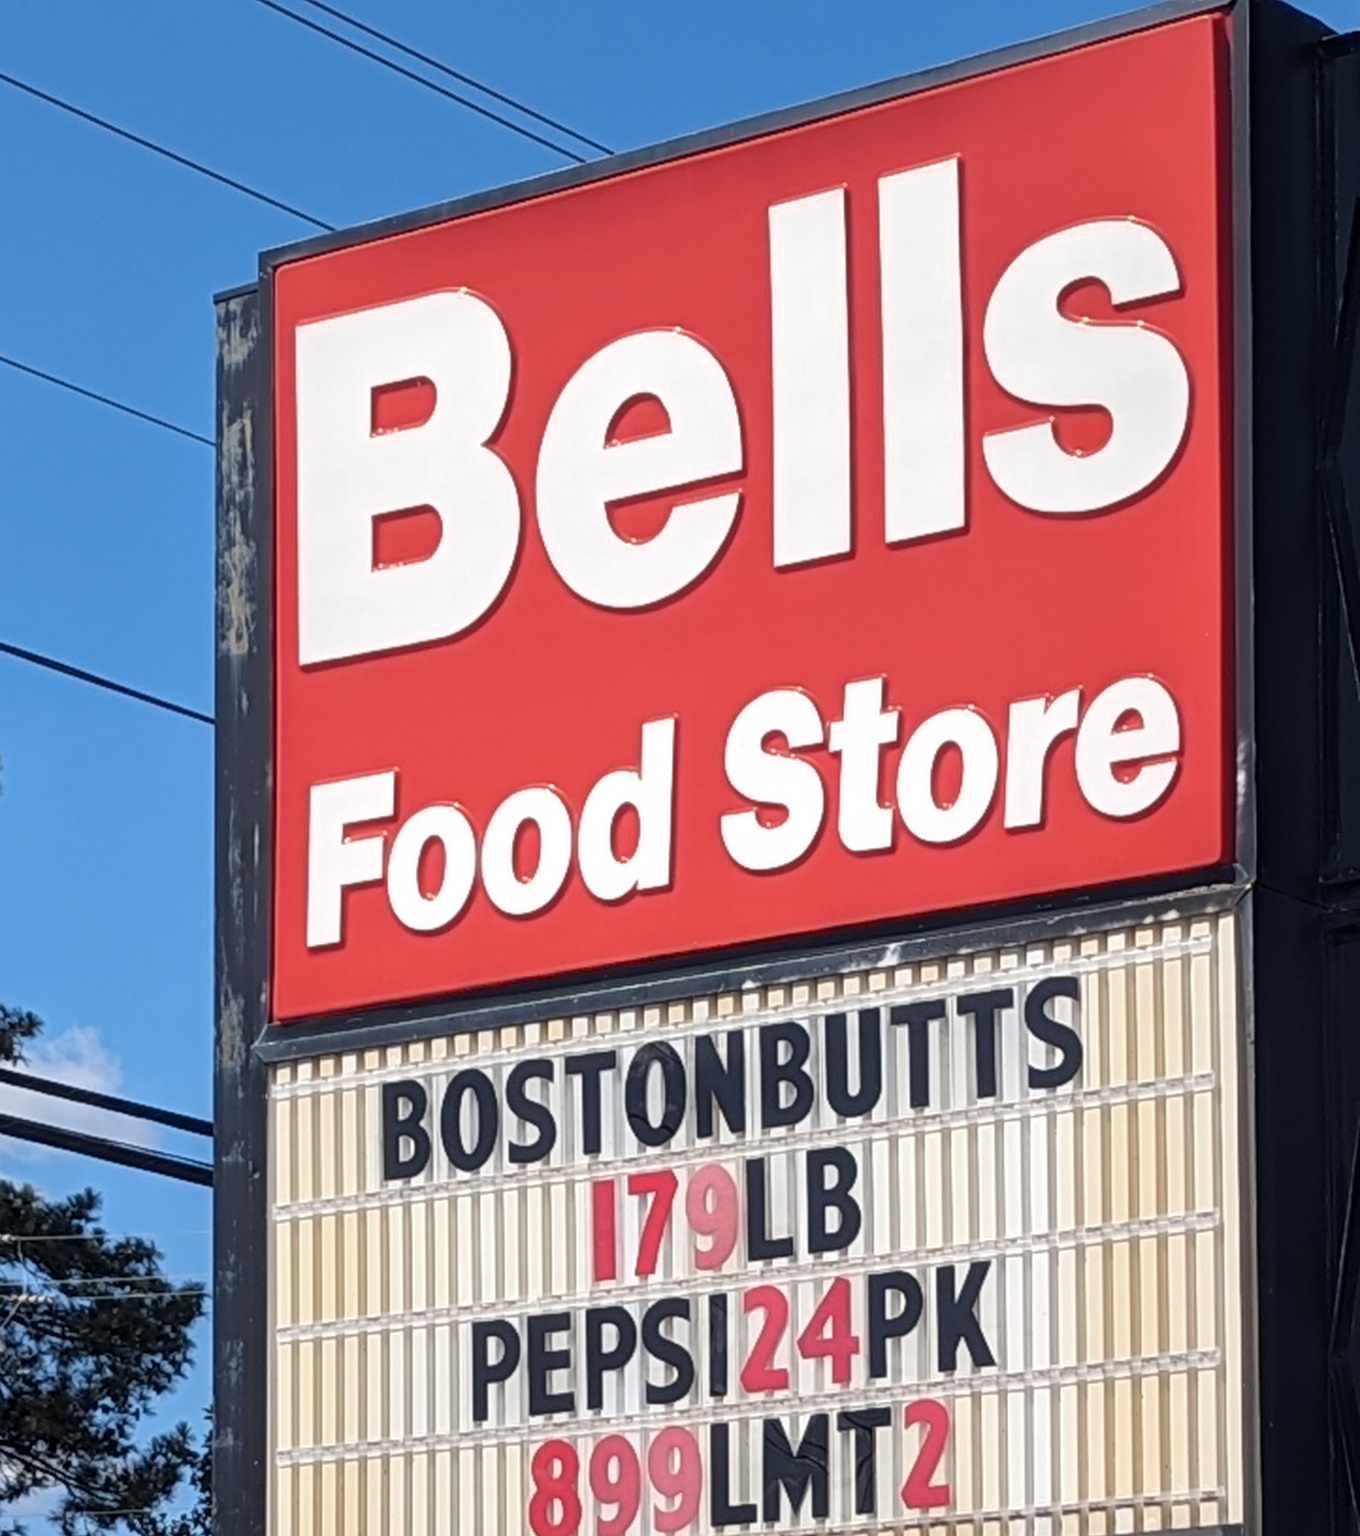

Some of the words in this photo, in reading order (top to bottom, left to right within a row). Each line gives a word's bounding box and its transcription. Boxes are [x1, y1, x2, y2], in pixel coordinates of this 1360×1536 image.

[296, 155, 1189, 667] Bells
[307, 716, 675, 948] Food
[721, 674, 1180, 871] Store
[382, 977, 1083, 1181] BOSTONBUTTS
[591, 1147, 862, 1281] 179LB
[472, 1261, 996, 1422] PEPSI24PK
